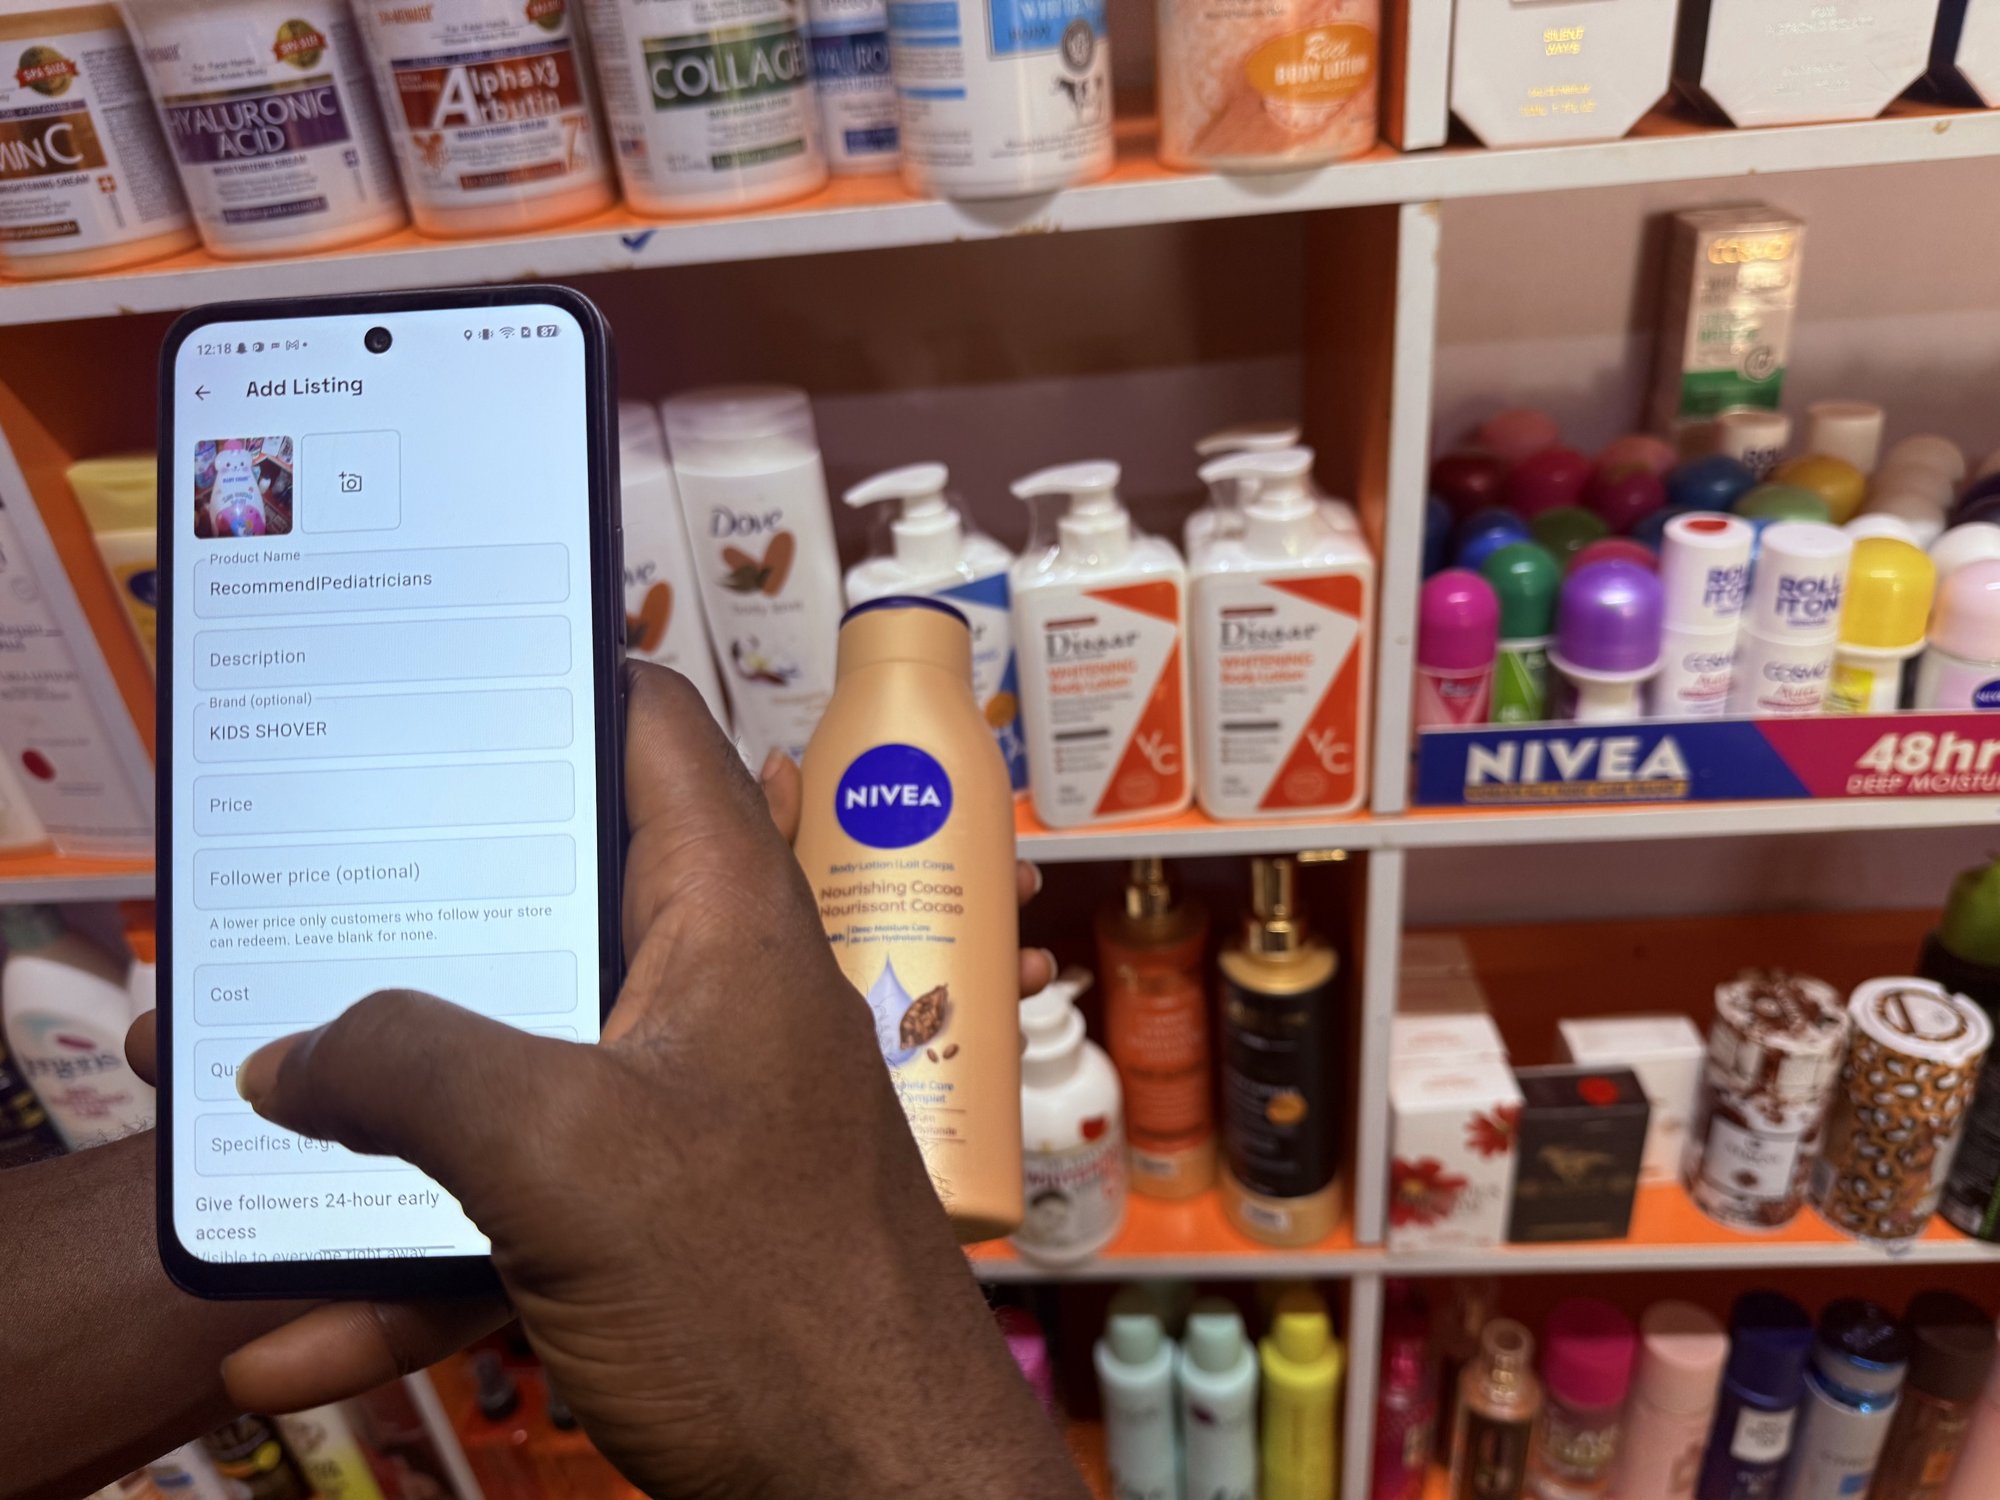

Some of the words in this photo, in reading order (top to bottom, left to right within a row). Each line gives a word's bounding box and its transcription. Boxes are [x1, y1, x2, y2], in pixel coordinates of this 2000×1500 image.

[166, 88, 337, 137] HYALURONIC
[217, 125, 286, 159] ACID
[540, 325, 557, 338] 87
[197, 343, 232, 356] 12:18
[246, 379, 287, 398] Add
[293, 375, 364, 398] Listing
[709, 504, 784, 540] Dove
[209, 551, 260, 565] Product
[263, 548, 301, 563] Name
[209, 648, 307, 669] Description
[209, 694, 247, 709] Brand
[250, 691, 313, 709] (optional)
[209, 724, 251, 741] KIDS
[255, 721, 328, 740] SHOVER
[1464, 734, 1691, 786] NIVEA
[1906, 770, 2000, 794] MOISTU
[209, 797, 254, 813] Price
[843, 783, 943, 811] NIVEA
[209, 868, 283, 887] Follower
[288, 867, 331, 888] price
[335, 861, 421, 886] (optional)
[820, 880, 908, 900] Nourishing
[911, 879, 964, 898] Cocoa
[209, 918, 220, 930] A
[222, 916, 260, 929] lower
[262, 915, 296, 931] price
[299, 913, 327, 930] only
[330, 911, 402, 928] customers
[405, 909, 434, 922] who
[437, 906, 480, 921] follow
[483, 906, 513, 922] your
[517, 904, 552, 918] store
[820, 899, 907, 919] Nourissant
[209, 938, 233, 949] can
[237, 934, 291, 948] redeem.
[295, 932, 334, 945] Leave
[337, 930, 374, 944] blank
[377, 929, 397, 942] for
[400, 930, 438, 942] none.
[210, 986, 250, 1003] Cost
[211, 1135, 291, 1156] Specifics
[195, 1196, 233, 1212] Give
[239, 1194, 320, 1211] followers
[325, 1191, 393, 1209] 24-hour
[397, 1190, 440, 1209] early
[195, 1227, 257, 1241] access
[251, 1251, 267, 1262] to
[272, 1250, 343, 1261] everyone
[387, 1248, 428, 1259] away
